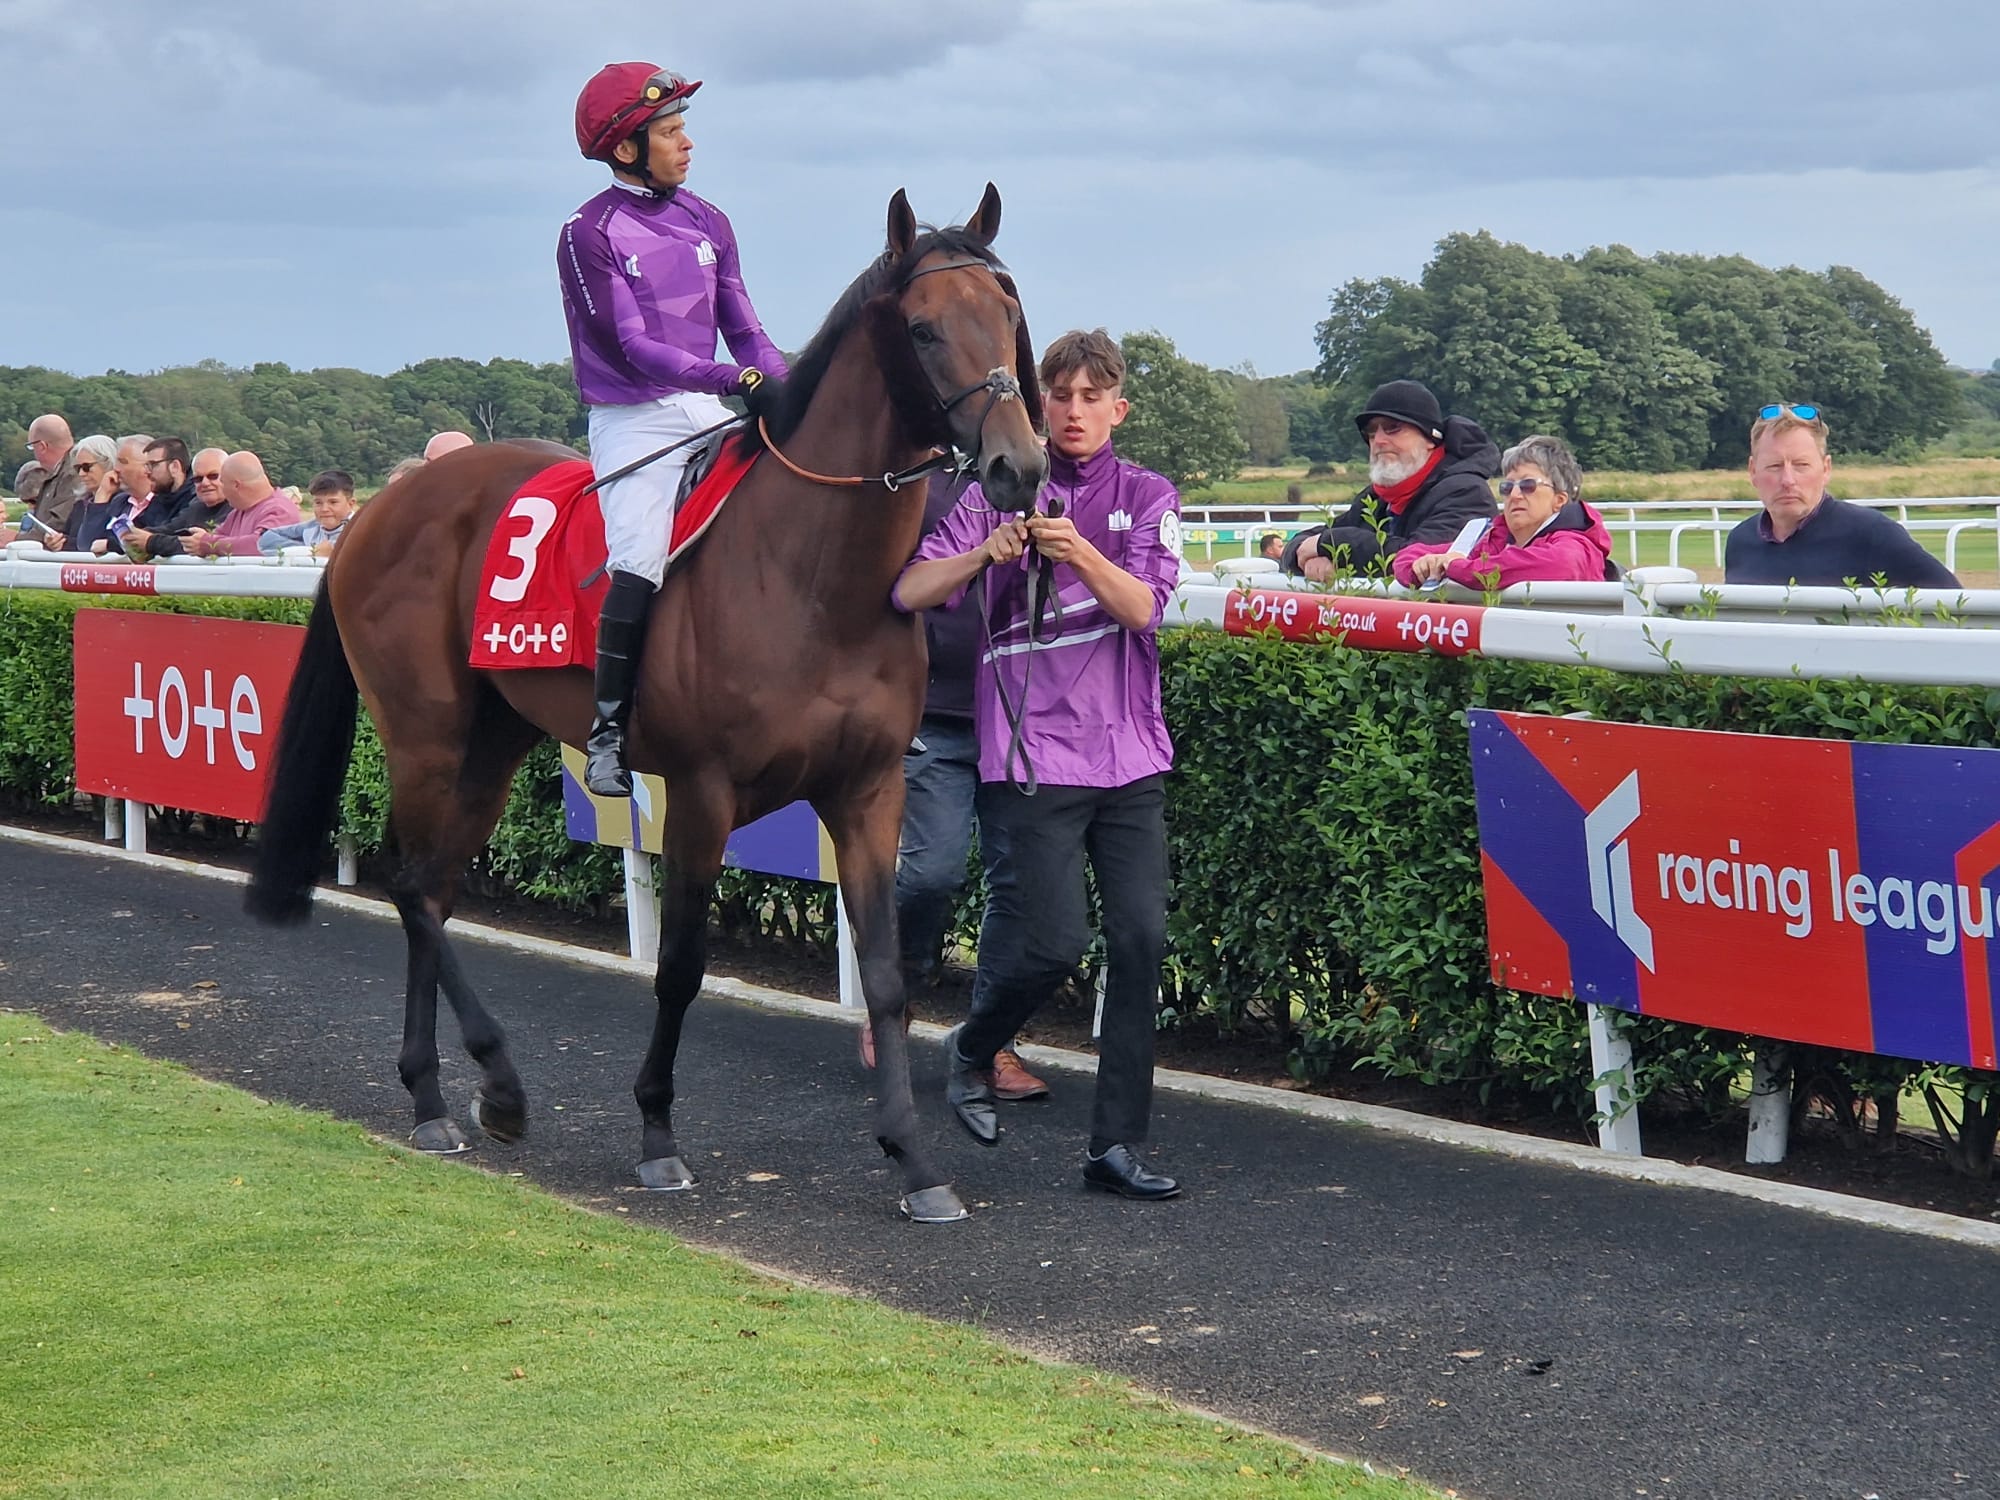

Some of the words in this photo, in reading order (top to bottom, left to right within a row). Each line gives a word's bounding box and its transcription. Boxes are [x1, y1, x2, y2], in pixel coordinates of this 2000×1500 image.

[568, 243, 585, 285] WINNERS
[582, 285, 597, 316] CIRCLE
[64, 568, 88, 586] tote
[124, 570, 151, 588] tote
[489, 496, 557, 602] 3
[483, 622, 567, 654] tote
[1234, 594, 1298, 626] tote
[1396, 612, 1469, 648] tote
[123, 661, 263, 771] tote
[1657, 838, 1812, 938] racing
[1828, 848, 2000, 955] leagu
